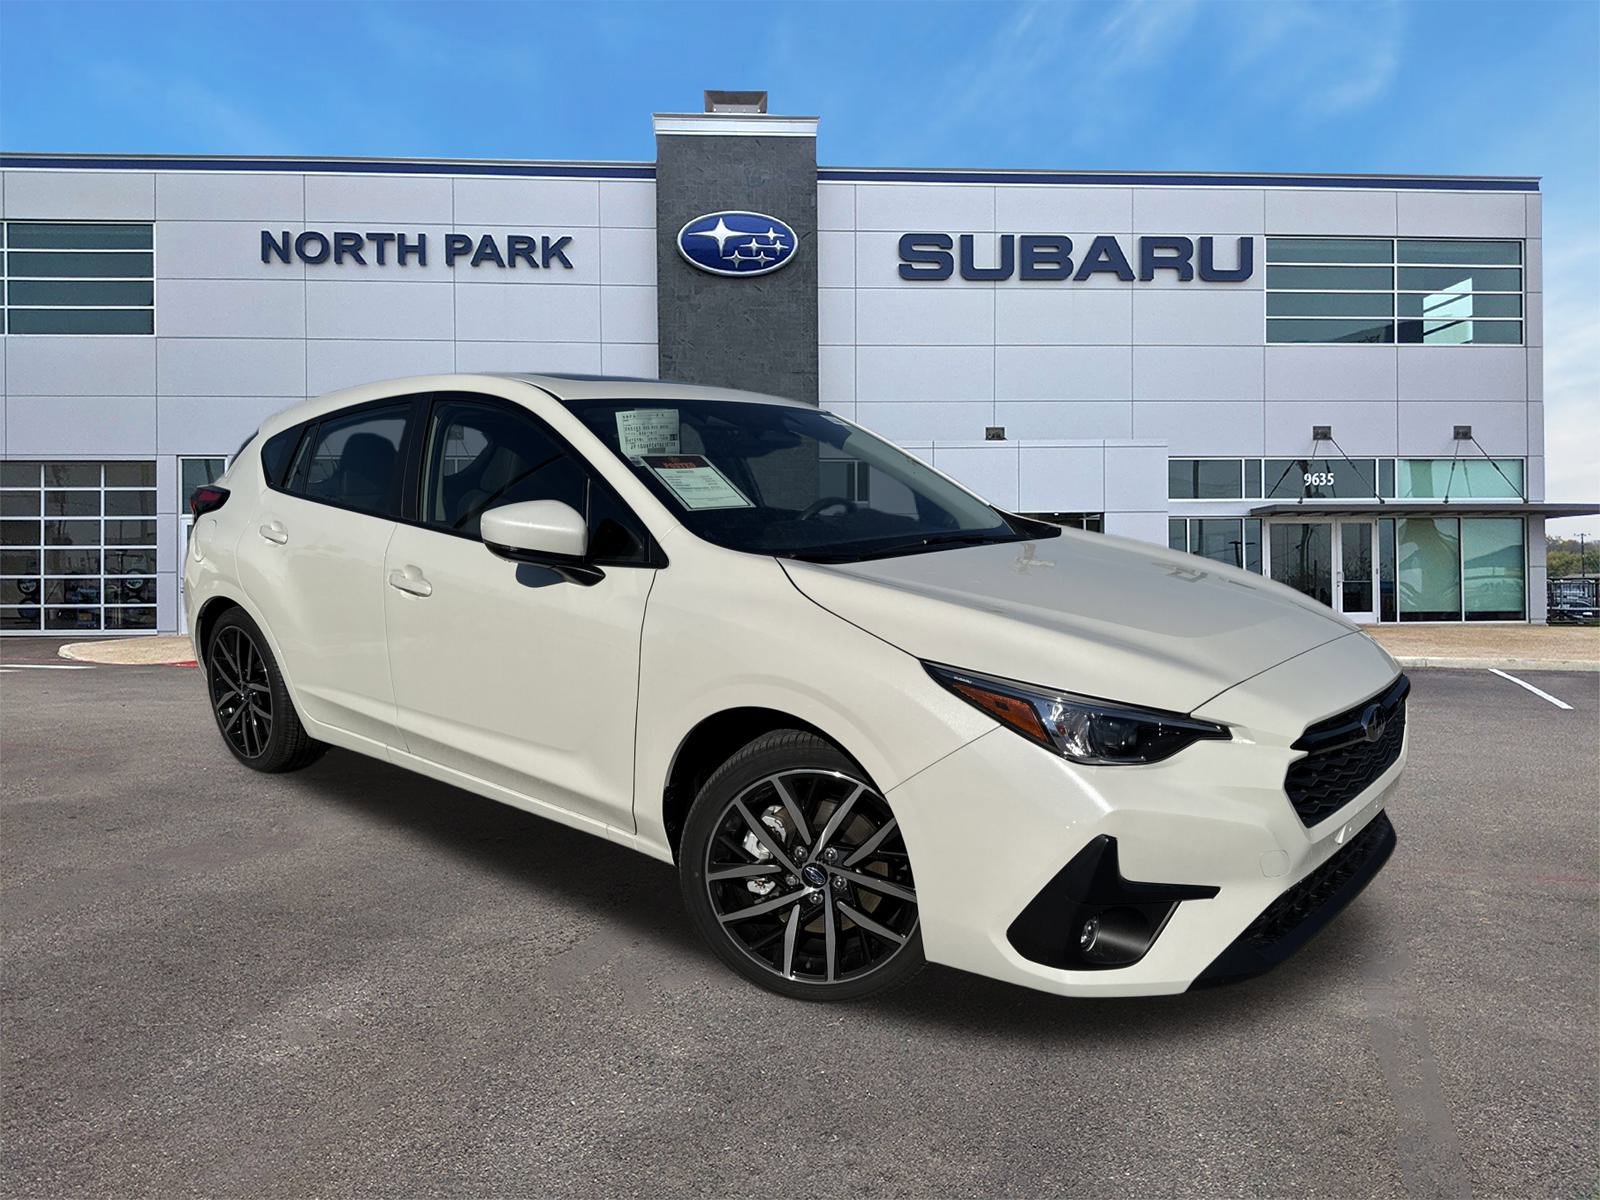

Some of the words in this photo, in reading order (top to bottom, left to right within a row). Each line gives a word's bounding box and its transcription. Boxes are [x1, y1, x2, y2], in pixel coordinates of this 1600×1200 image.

[260, 230, 427, 266] NORTH
[445, 233, 574, 269] PARK
[898, 232, 1254, 282] SUBARU
[1303, 472, 1335, 486] 9635
